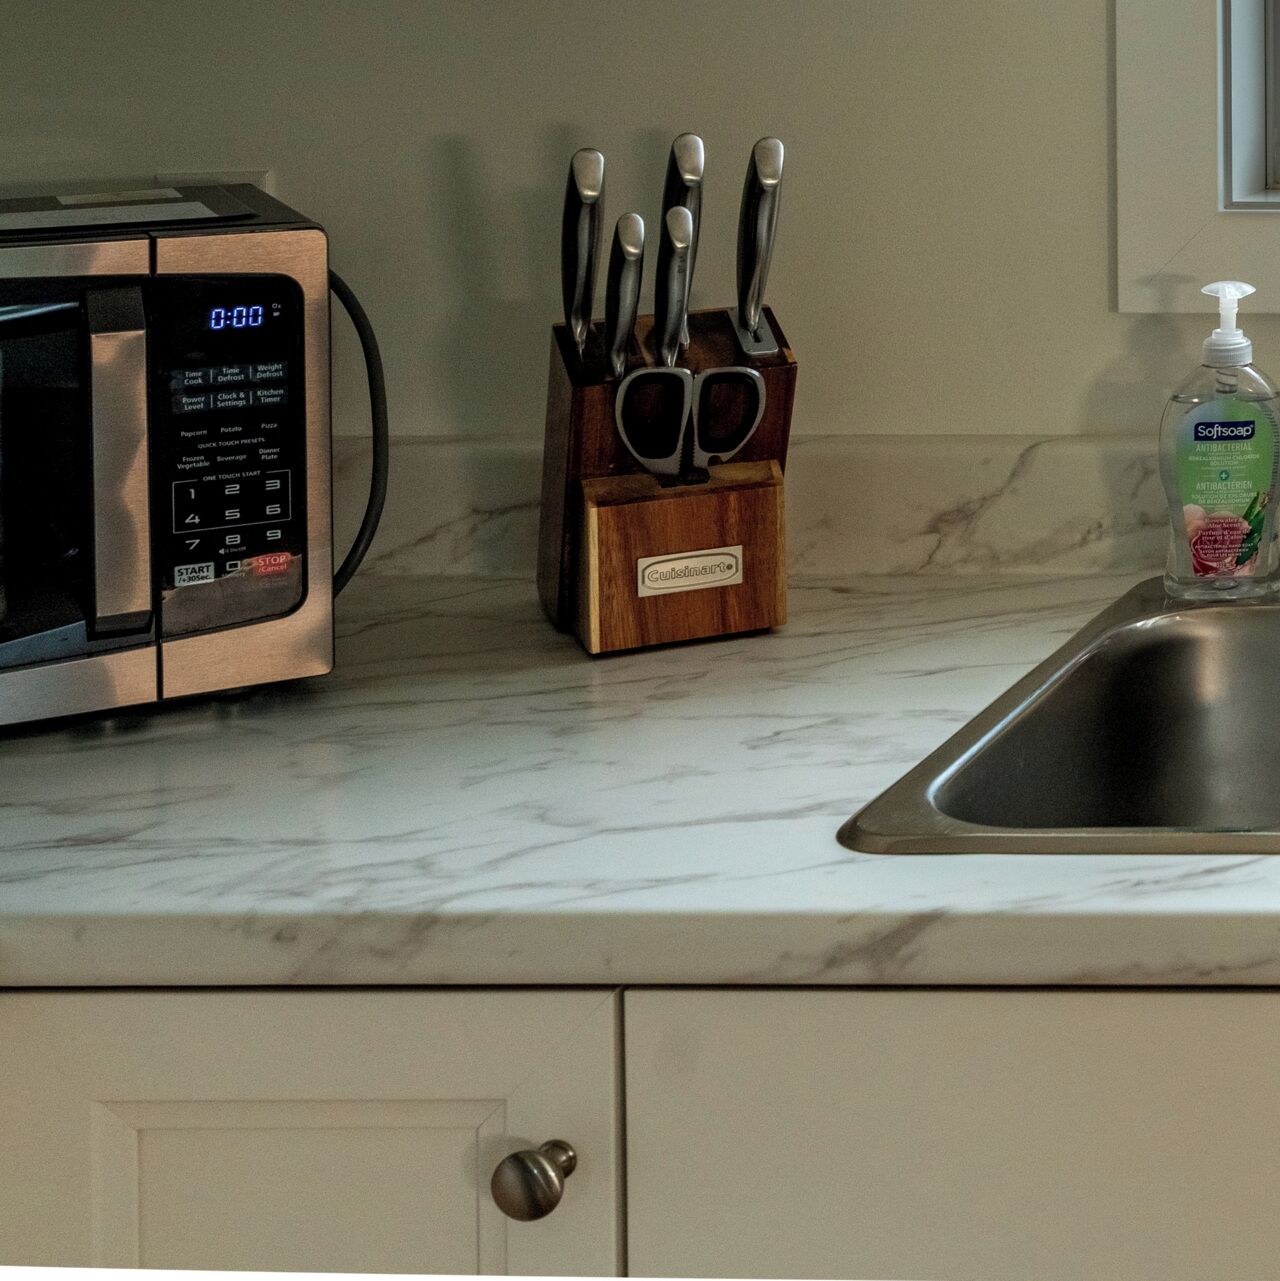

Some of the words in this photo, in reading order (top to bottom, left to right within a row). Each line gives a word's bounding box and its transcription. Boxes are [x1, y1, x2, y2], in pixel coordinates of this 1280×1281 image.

[211, 306, 263, 329] 0:00
[217, 399, 246, 407] Settings
[1198, 424, 1252, 439] Softsoap
[1196, 442, 1252, 452] ANTIBACTERIAL
[176, 461, 210, 470] Vegetable
[189, 488, 195, 499] 1
[225, 484, 240, 495] 2
[265, 479, 280, 490] 3
[1196, 481, 1252, 490] ANTIBACTÉRIEN
[185, 513, 200, 524] 4
[225, 509, 240, 520] 5
[266, 504, 281, 515] 6
[185, 539, 200, 550] 7
[225, 534, 240, 545] 8
[266, 530, 281, 540] 9
[226, 561, 240, 571] 0
[258, 555, 286, 566] STOP
[177, 565, 211, 576] START
[258, 564, 286, 572] /Cancel
[648, 562, 726, 582] Cuisinart
